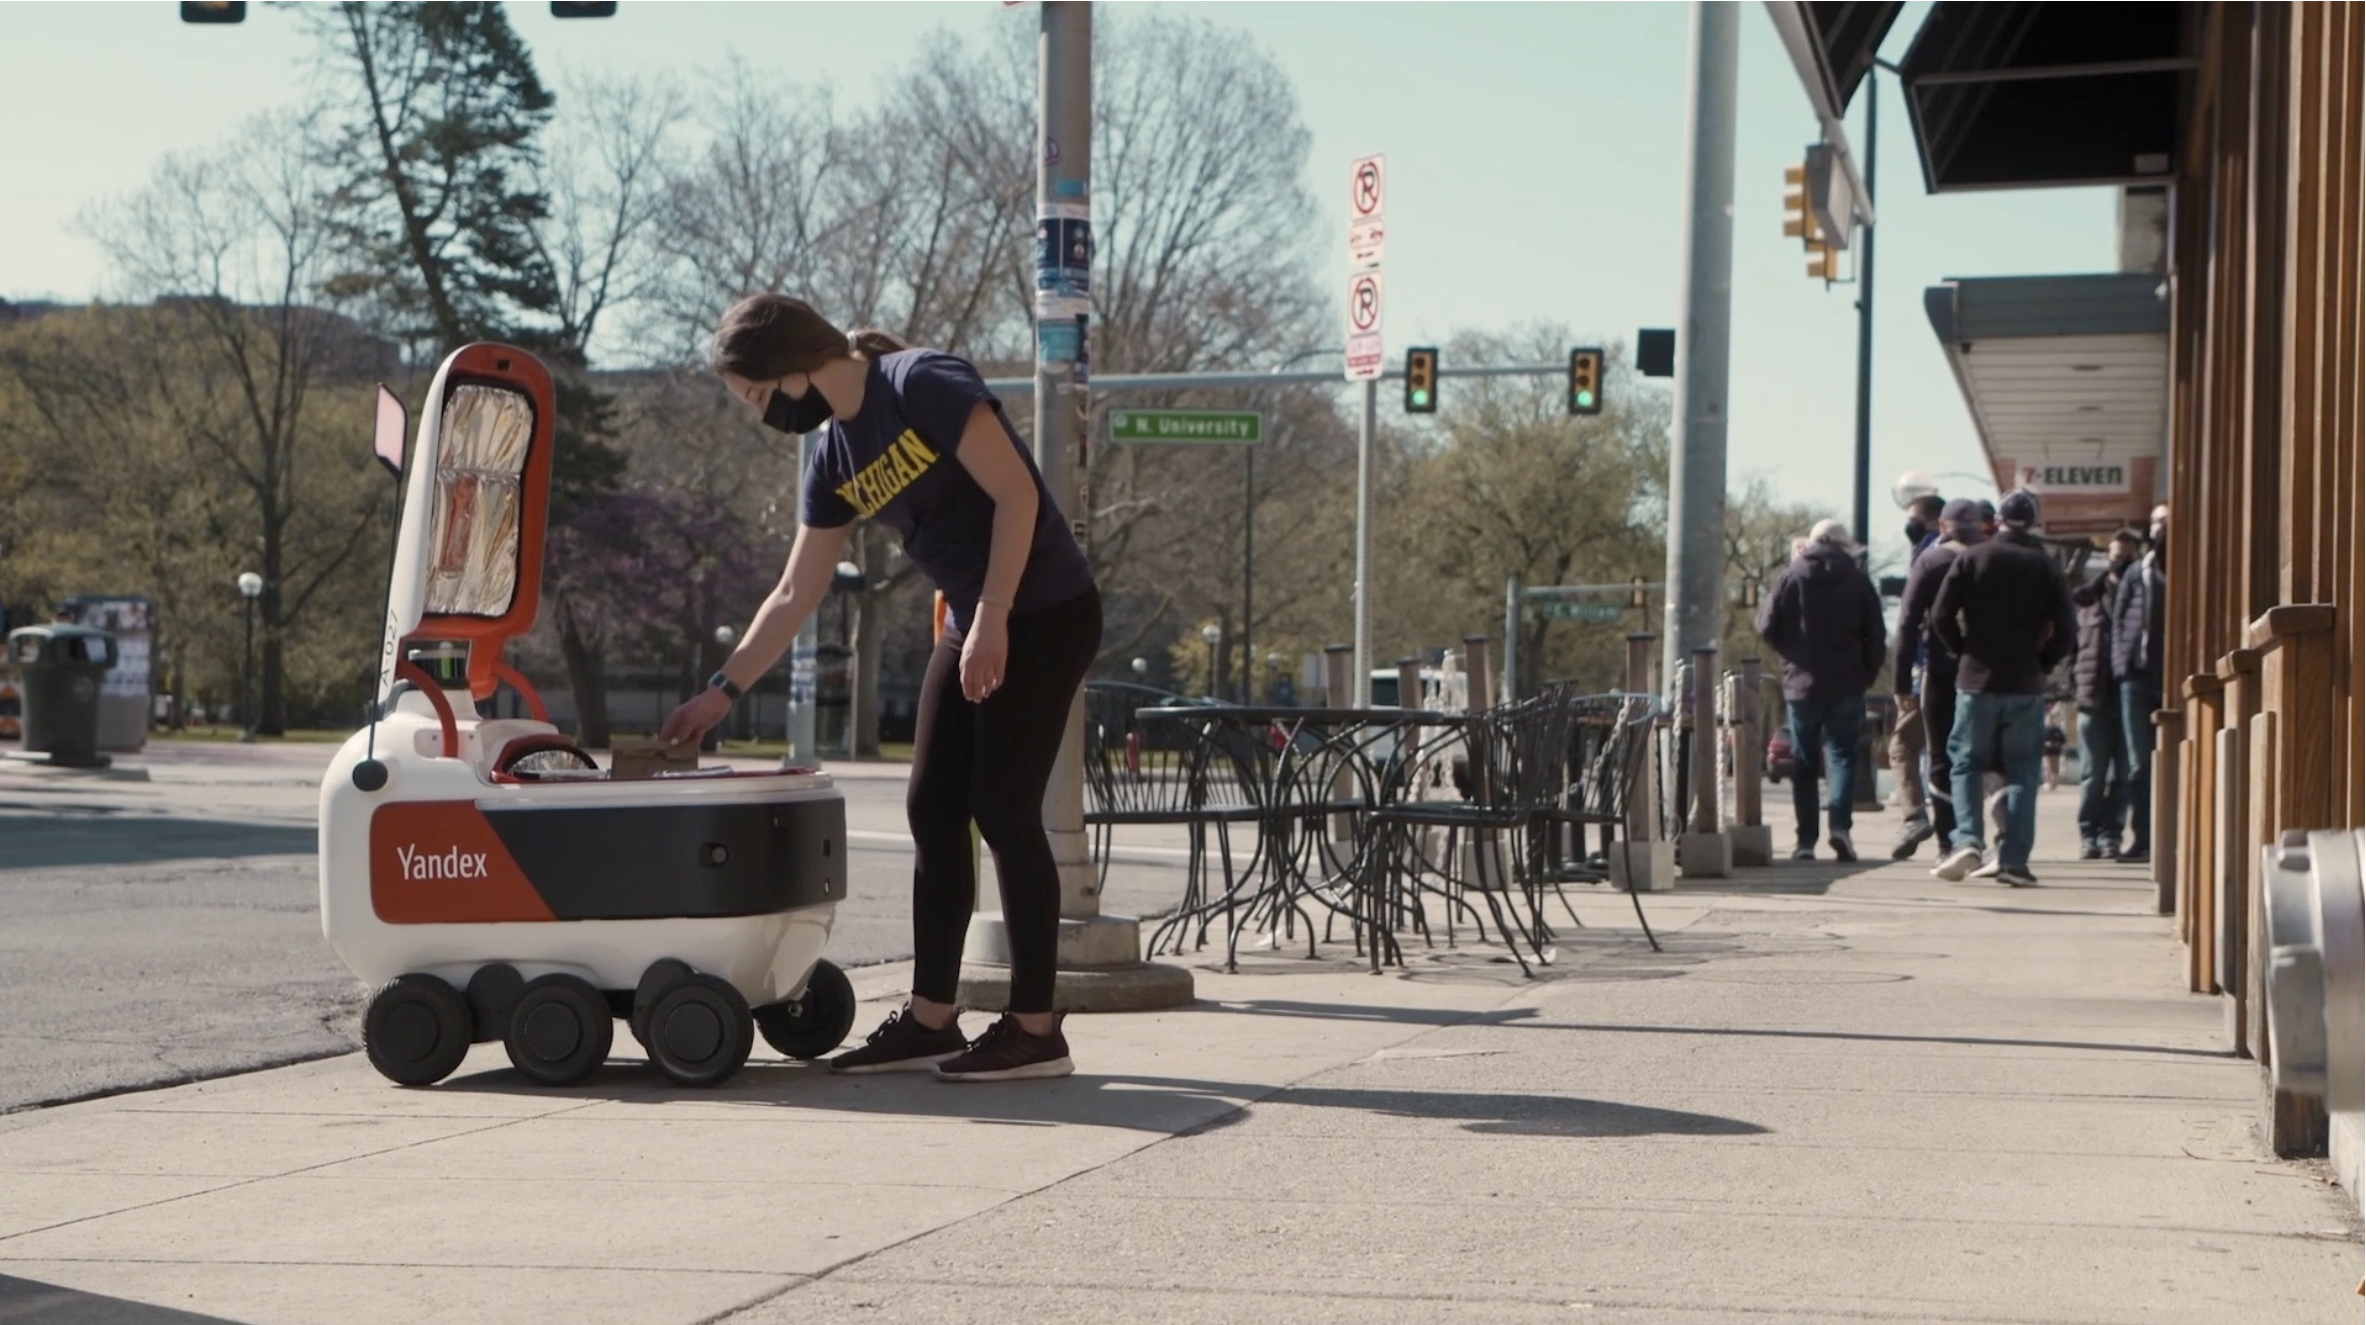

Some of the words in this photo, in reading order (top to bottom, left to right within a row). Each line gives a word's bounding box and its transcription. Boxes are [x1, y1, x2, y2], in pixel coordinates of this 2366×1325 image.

[1136, 416, 1153, 433] N.
[1158, 416, 1249, 438] University
[380, 609, 398, 687] A-027
[397, 843, 488, 880] Yandex
